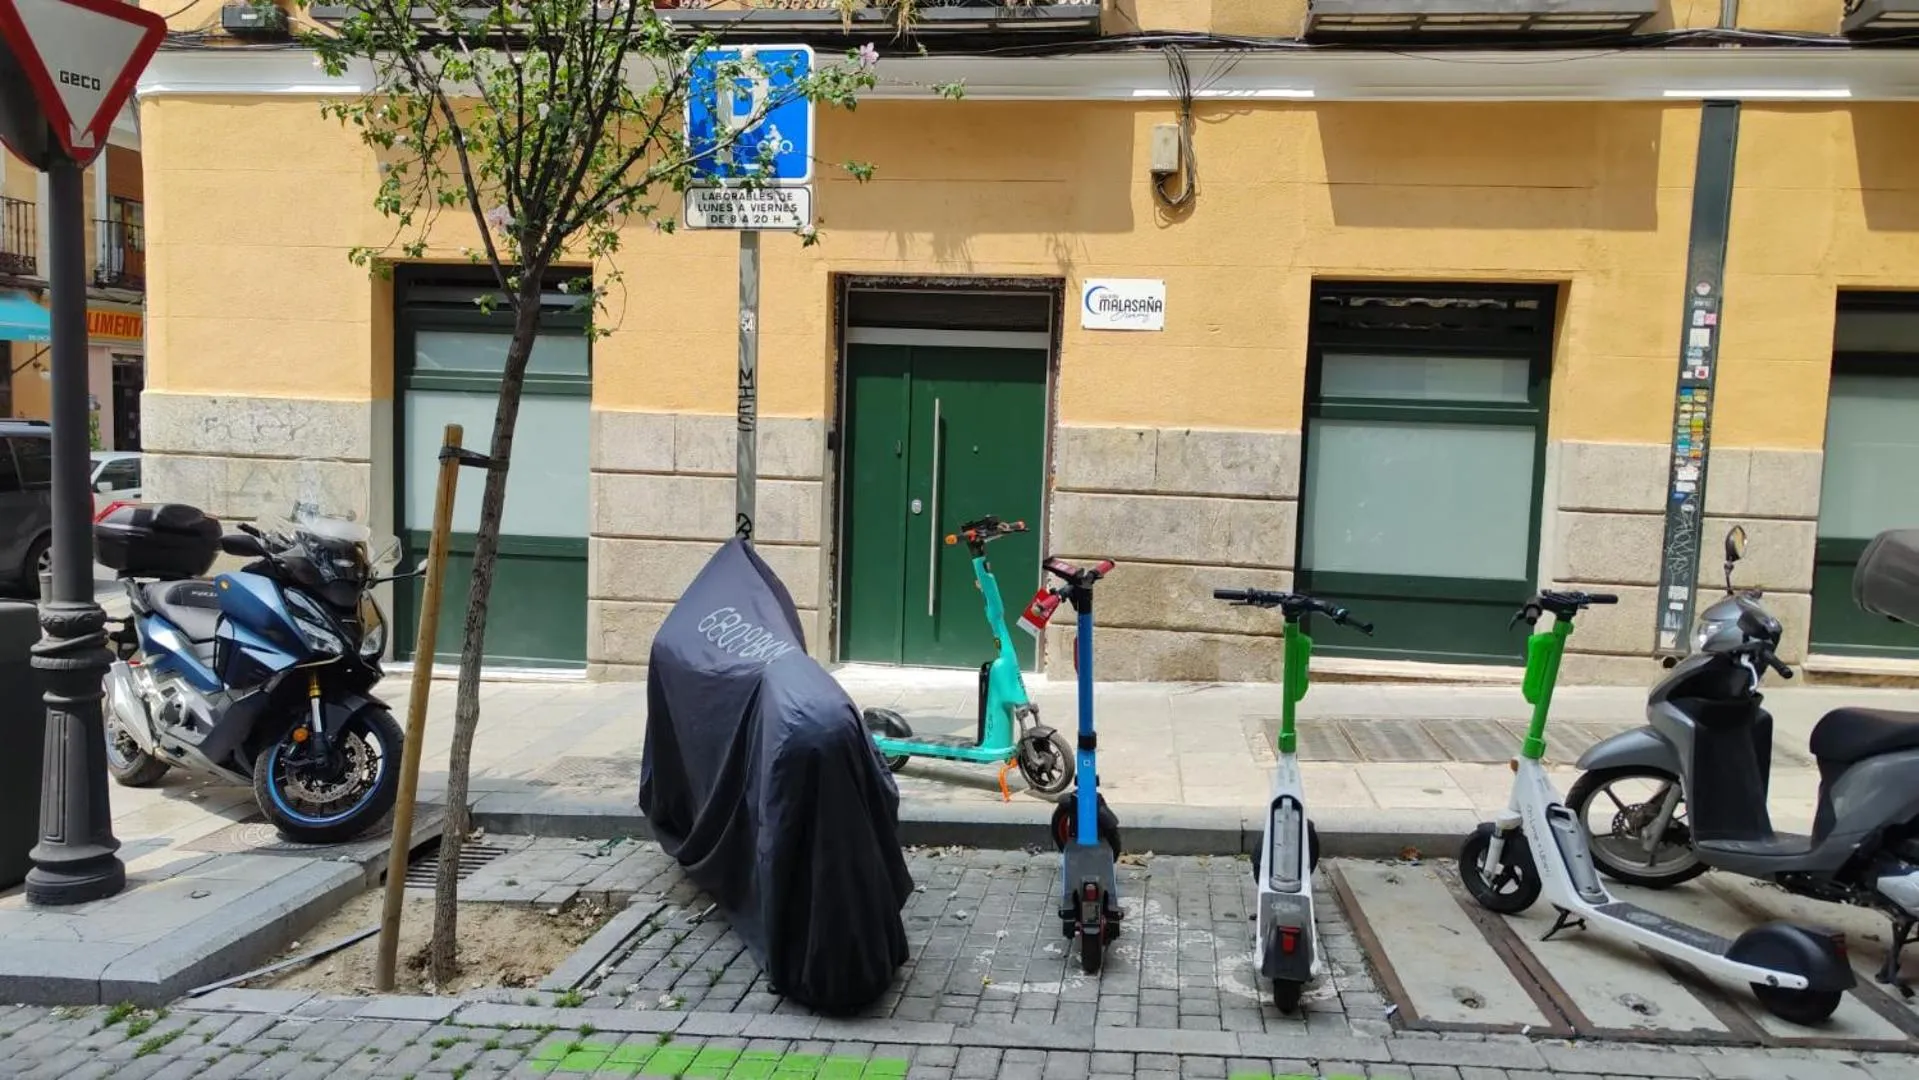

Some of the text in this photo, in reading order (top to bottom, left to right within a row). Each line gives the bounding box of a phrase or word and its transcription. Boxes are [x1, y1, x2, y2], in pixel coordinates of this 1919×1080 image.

[717, 61, 769, 165] P
[701, 191, 793, 202] LABORABLES DE
[697, 203, 798, 213] LUNES A VIERNES
[710, 214, 725, 224] DE
[729, 214, 737, 224] 8
[741, 215, 749, 224] A
[754, 214, 769, 224] 20
[1099, 296, 1163, 313] MALASAÑA
